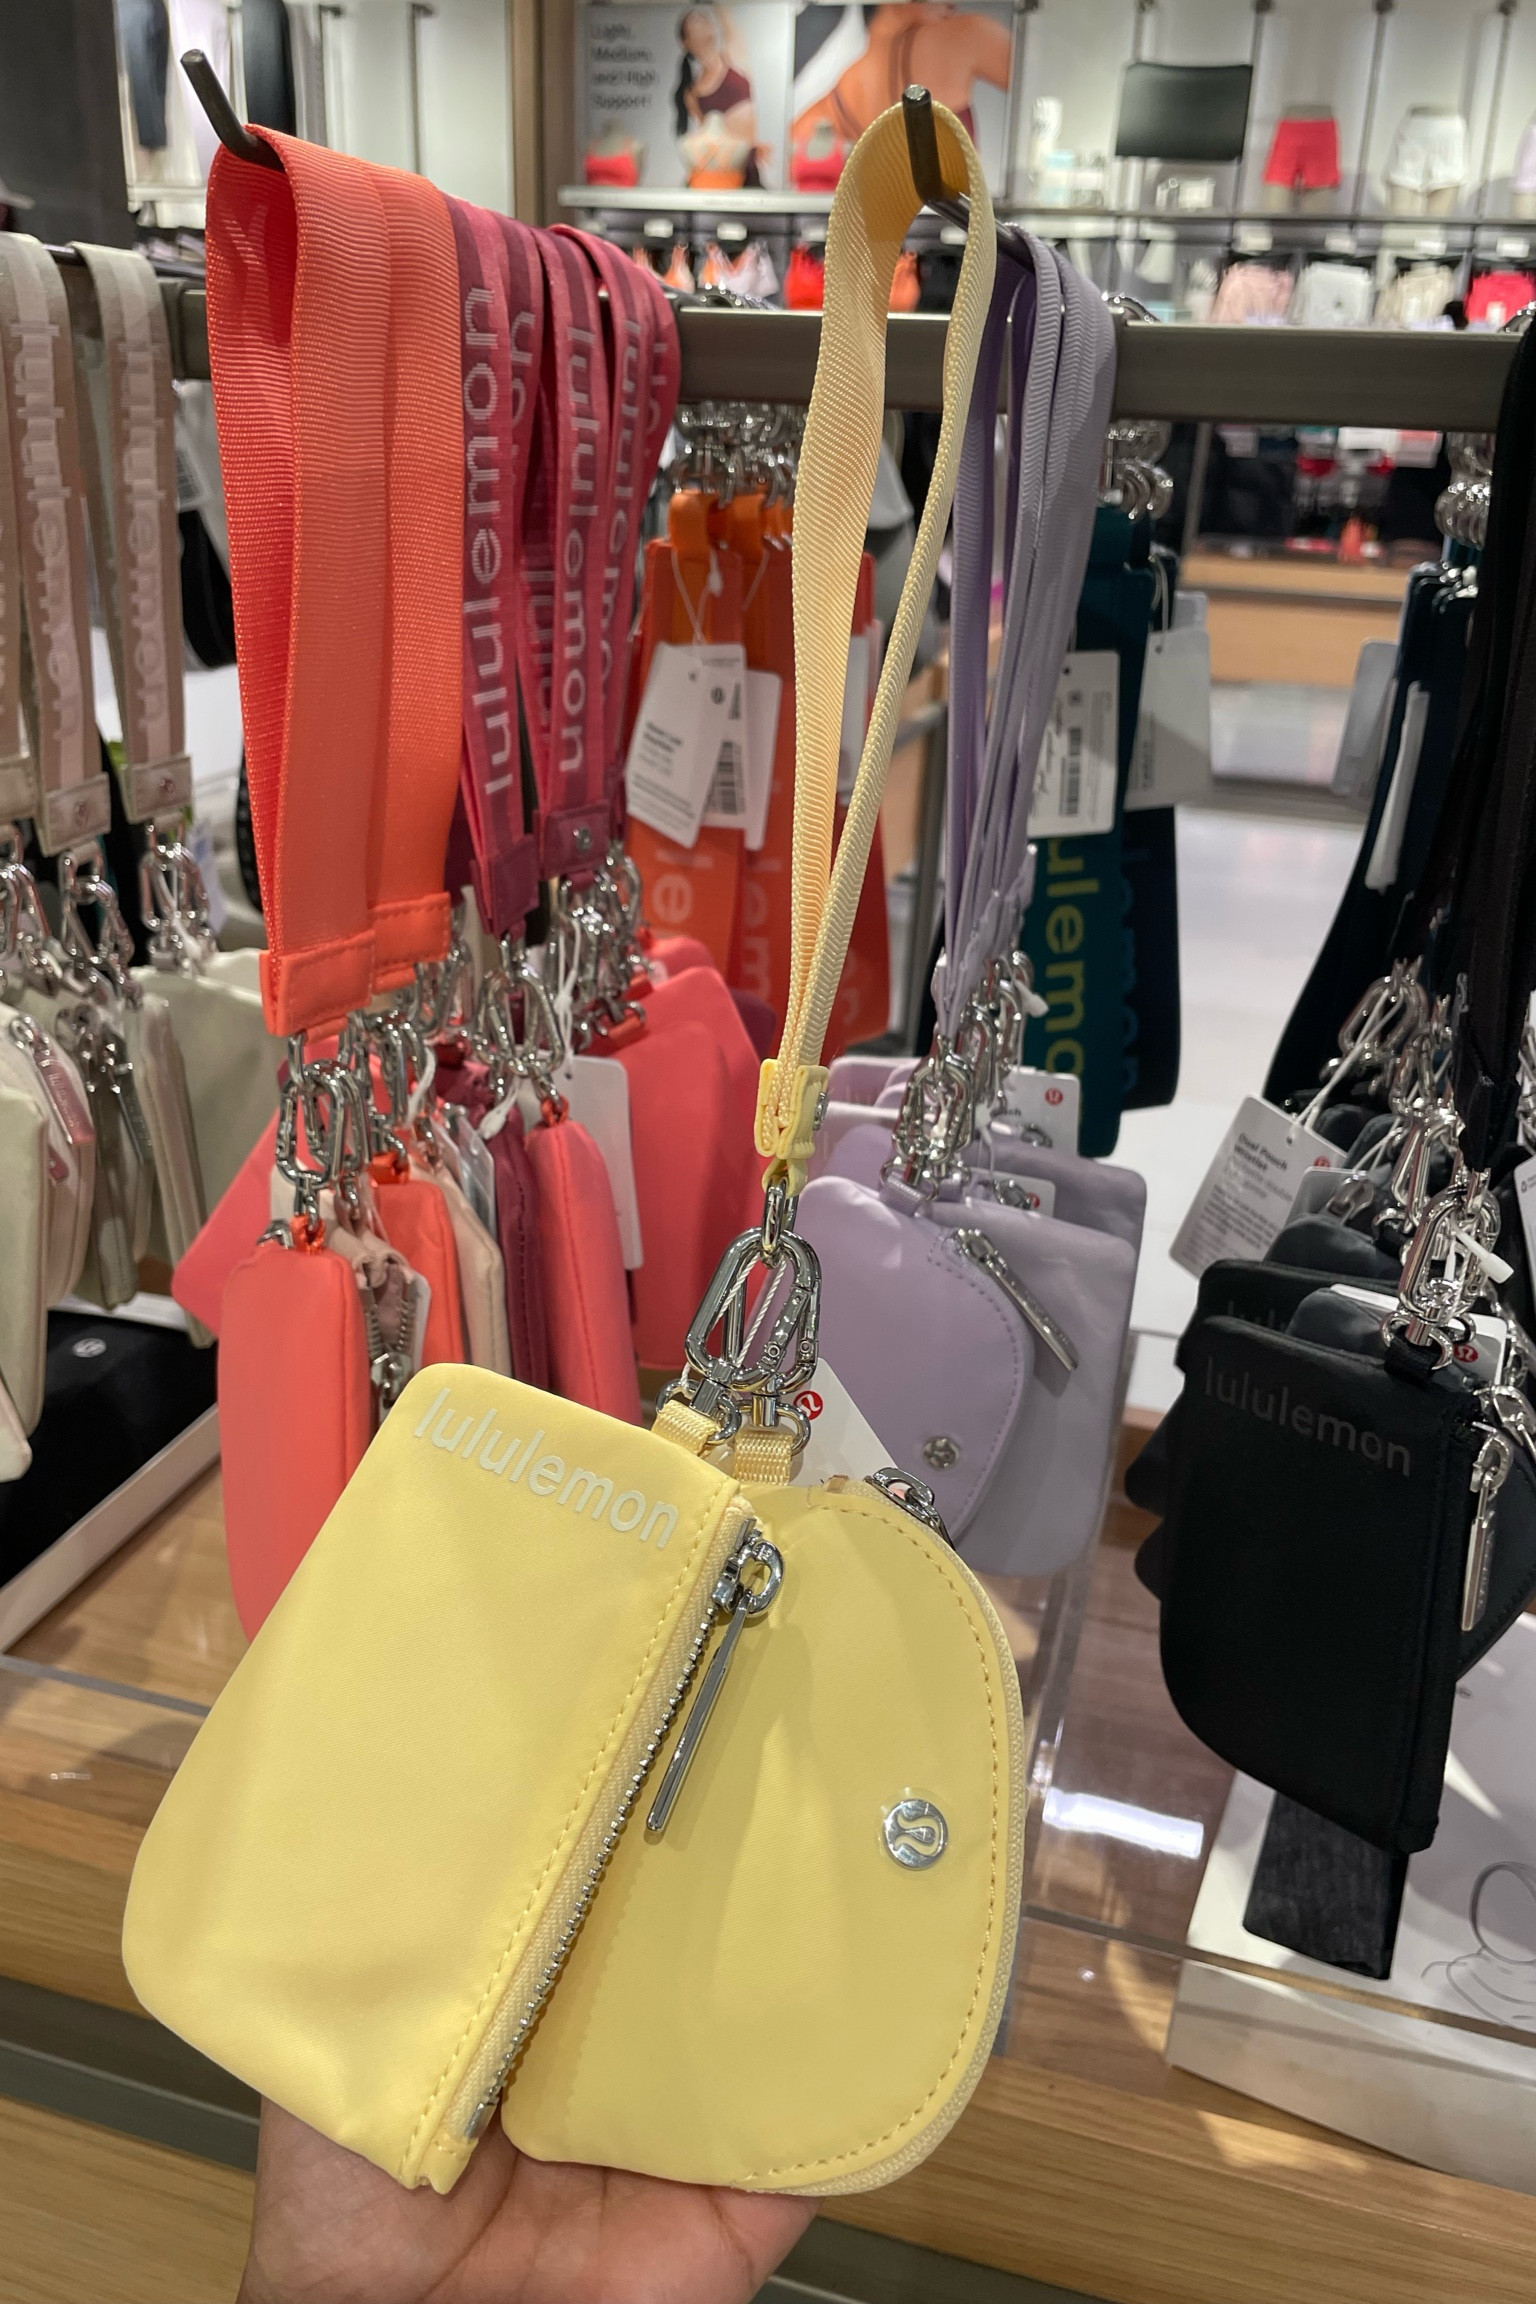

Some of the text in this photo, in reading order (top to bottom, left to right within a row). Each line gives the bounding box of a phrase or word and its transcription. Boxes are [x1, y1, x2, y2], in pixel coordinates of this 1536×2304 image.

[9, 322, 77, 741] lululemon
[464, 286, 513, 796] lululemon
[559, 326, 600, 772] lululemon
[1045, 838, 1100, 1078] ulemo
[414, 1387, 680, 1549] lululemon
[1204, 1356, 1411, 1477] lululemon
